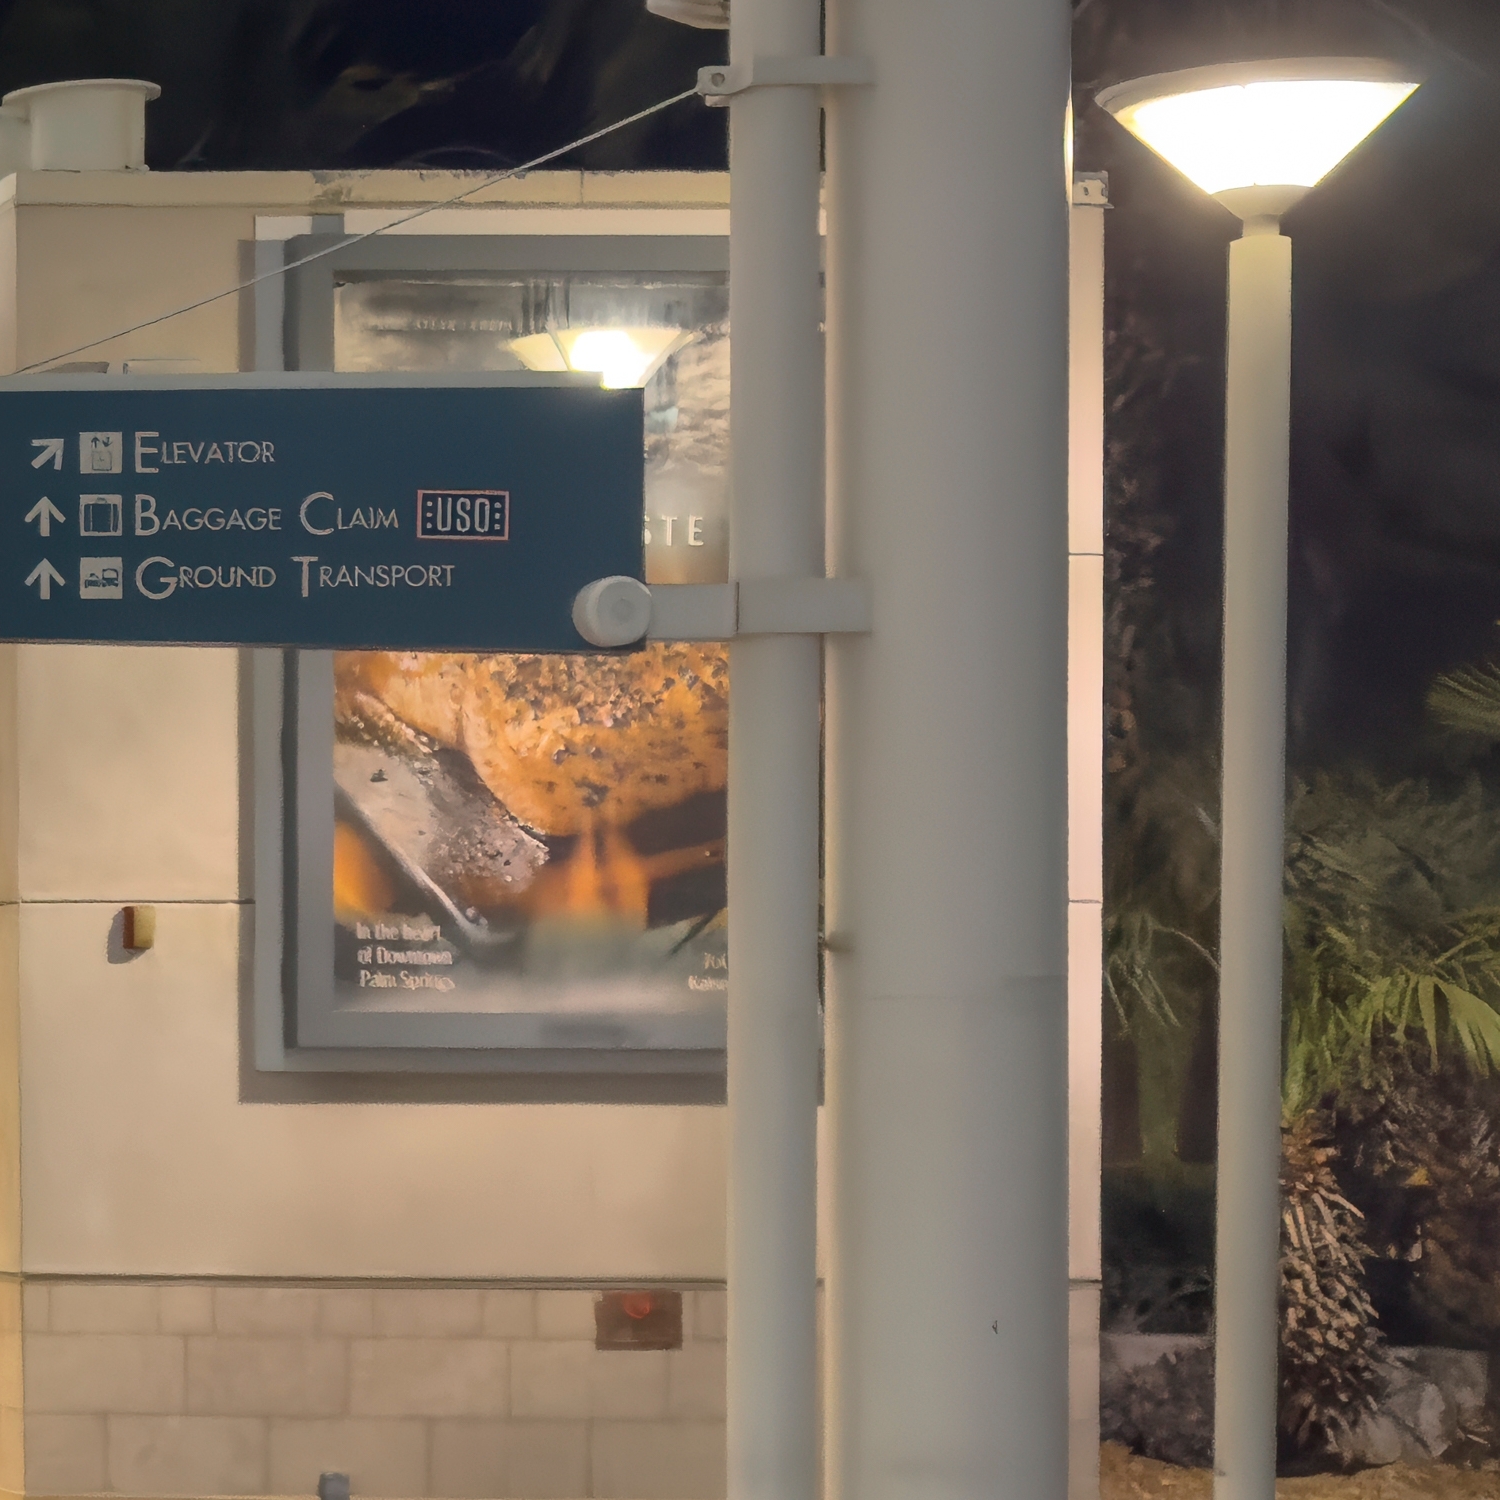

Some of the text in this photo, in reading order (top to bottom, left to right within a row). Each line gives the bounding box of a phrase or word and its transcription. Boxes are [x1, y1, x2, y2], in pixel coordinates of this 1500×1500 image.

[134, 431, 275, 474] ELEVATOR
[134, 491, 399, 537] BAGGAGE CLAIM
[436, 497, 490, 533] USO
[135, 555, 455, 600] GROUND TRANSPORT
